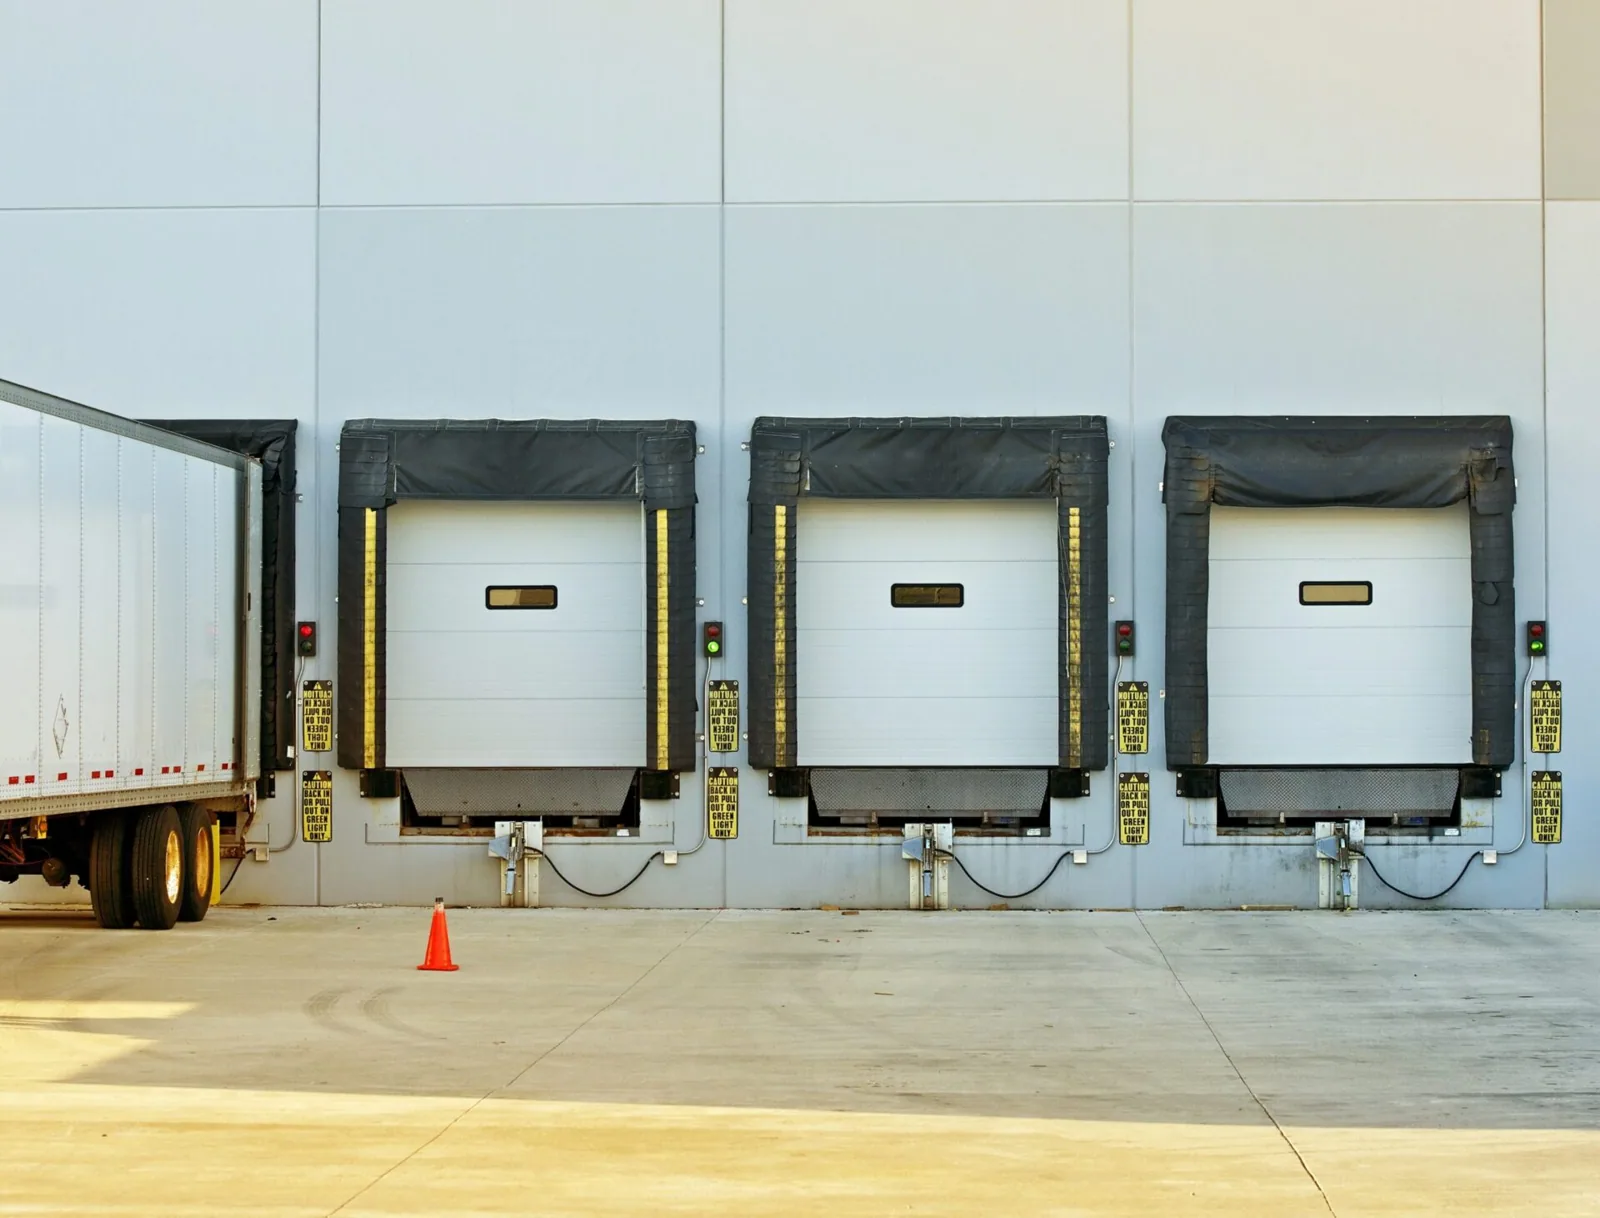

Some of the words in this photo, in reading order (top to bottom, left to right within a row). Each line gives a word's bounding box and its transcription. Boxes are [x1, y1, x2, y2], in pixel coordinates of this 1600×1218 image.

[709, 777, 738, 785] CAUTION
[1532, 781, 1561, 789] CAUTION
[710, 786, 728, 794] BACK
[730, 786, 736, 794] IN
[1120, 783, 1149, 791] CAUTION
[1534, 790, 1551, 798] BACK
[710, 795, 719, 803] OR
[721, 795, 736, 803] PULL
[1534, 799, 1543, 807] OR
[712, 812, 734, 820] GREEN
[1121, 809, 1135, 817] OUT
[1138, 809, 1146, 817] ON
[1550, 808, 1559, 816] ON
[1537, 825, 1557, 833] LIGHT
